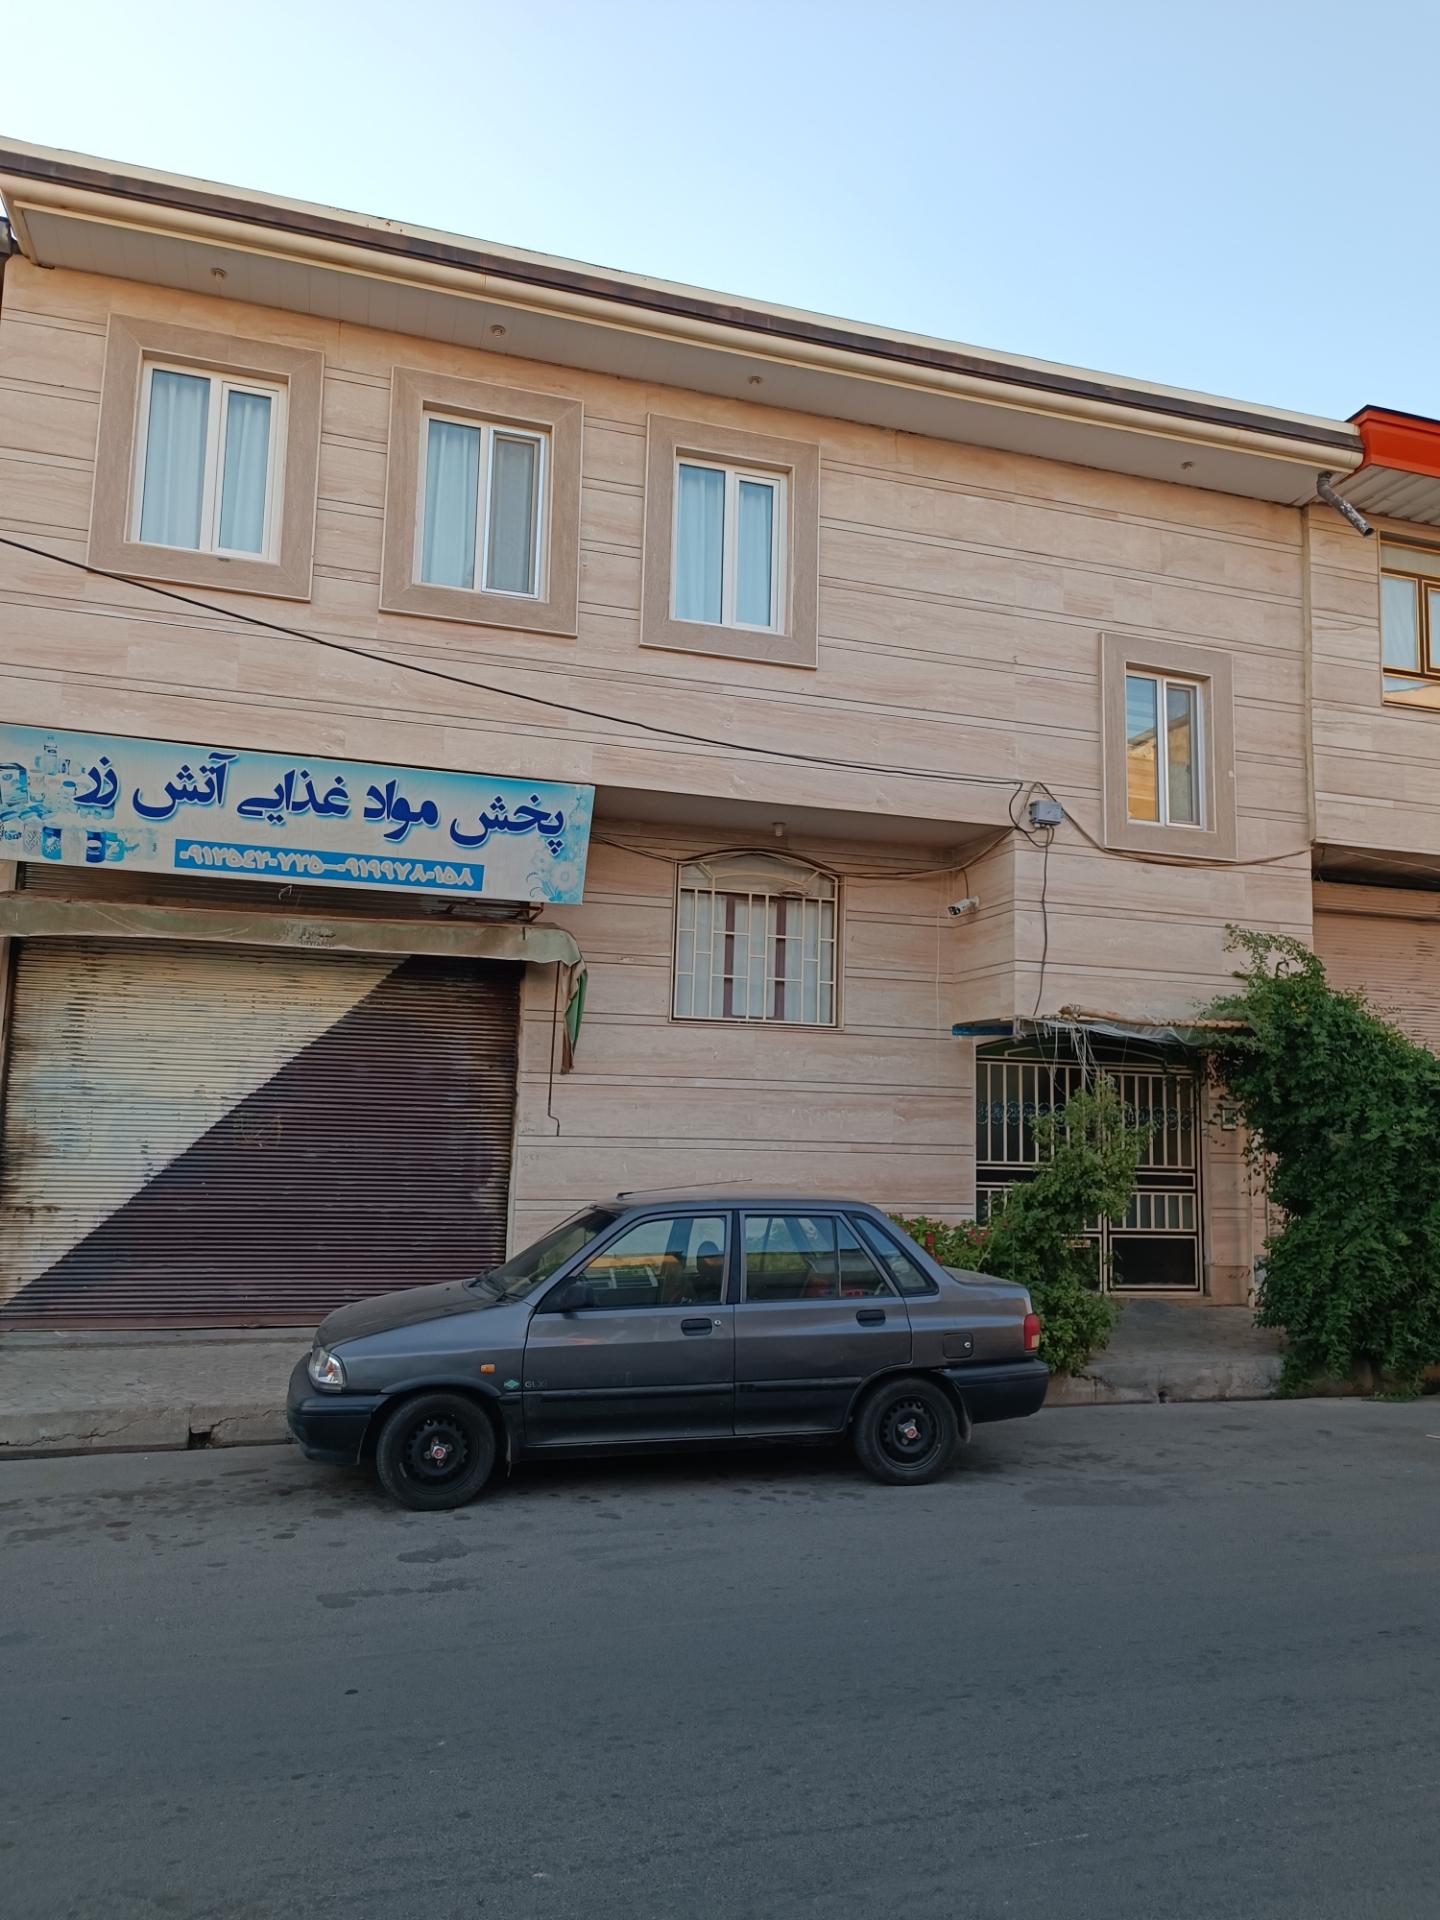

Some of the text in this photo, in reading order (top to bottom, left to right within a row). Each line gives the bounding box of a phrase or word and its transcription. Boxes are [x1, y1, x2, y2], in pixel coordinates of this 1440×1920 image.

[133, 753, 236, 818] آتش
[237, 770, 349, 823] غذایی
[364, 779, 439, 840] مواد
[450, 795, 565, 855] پخش
